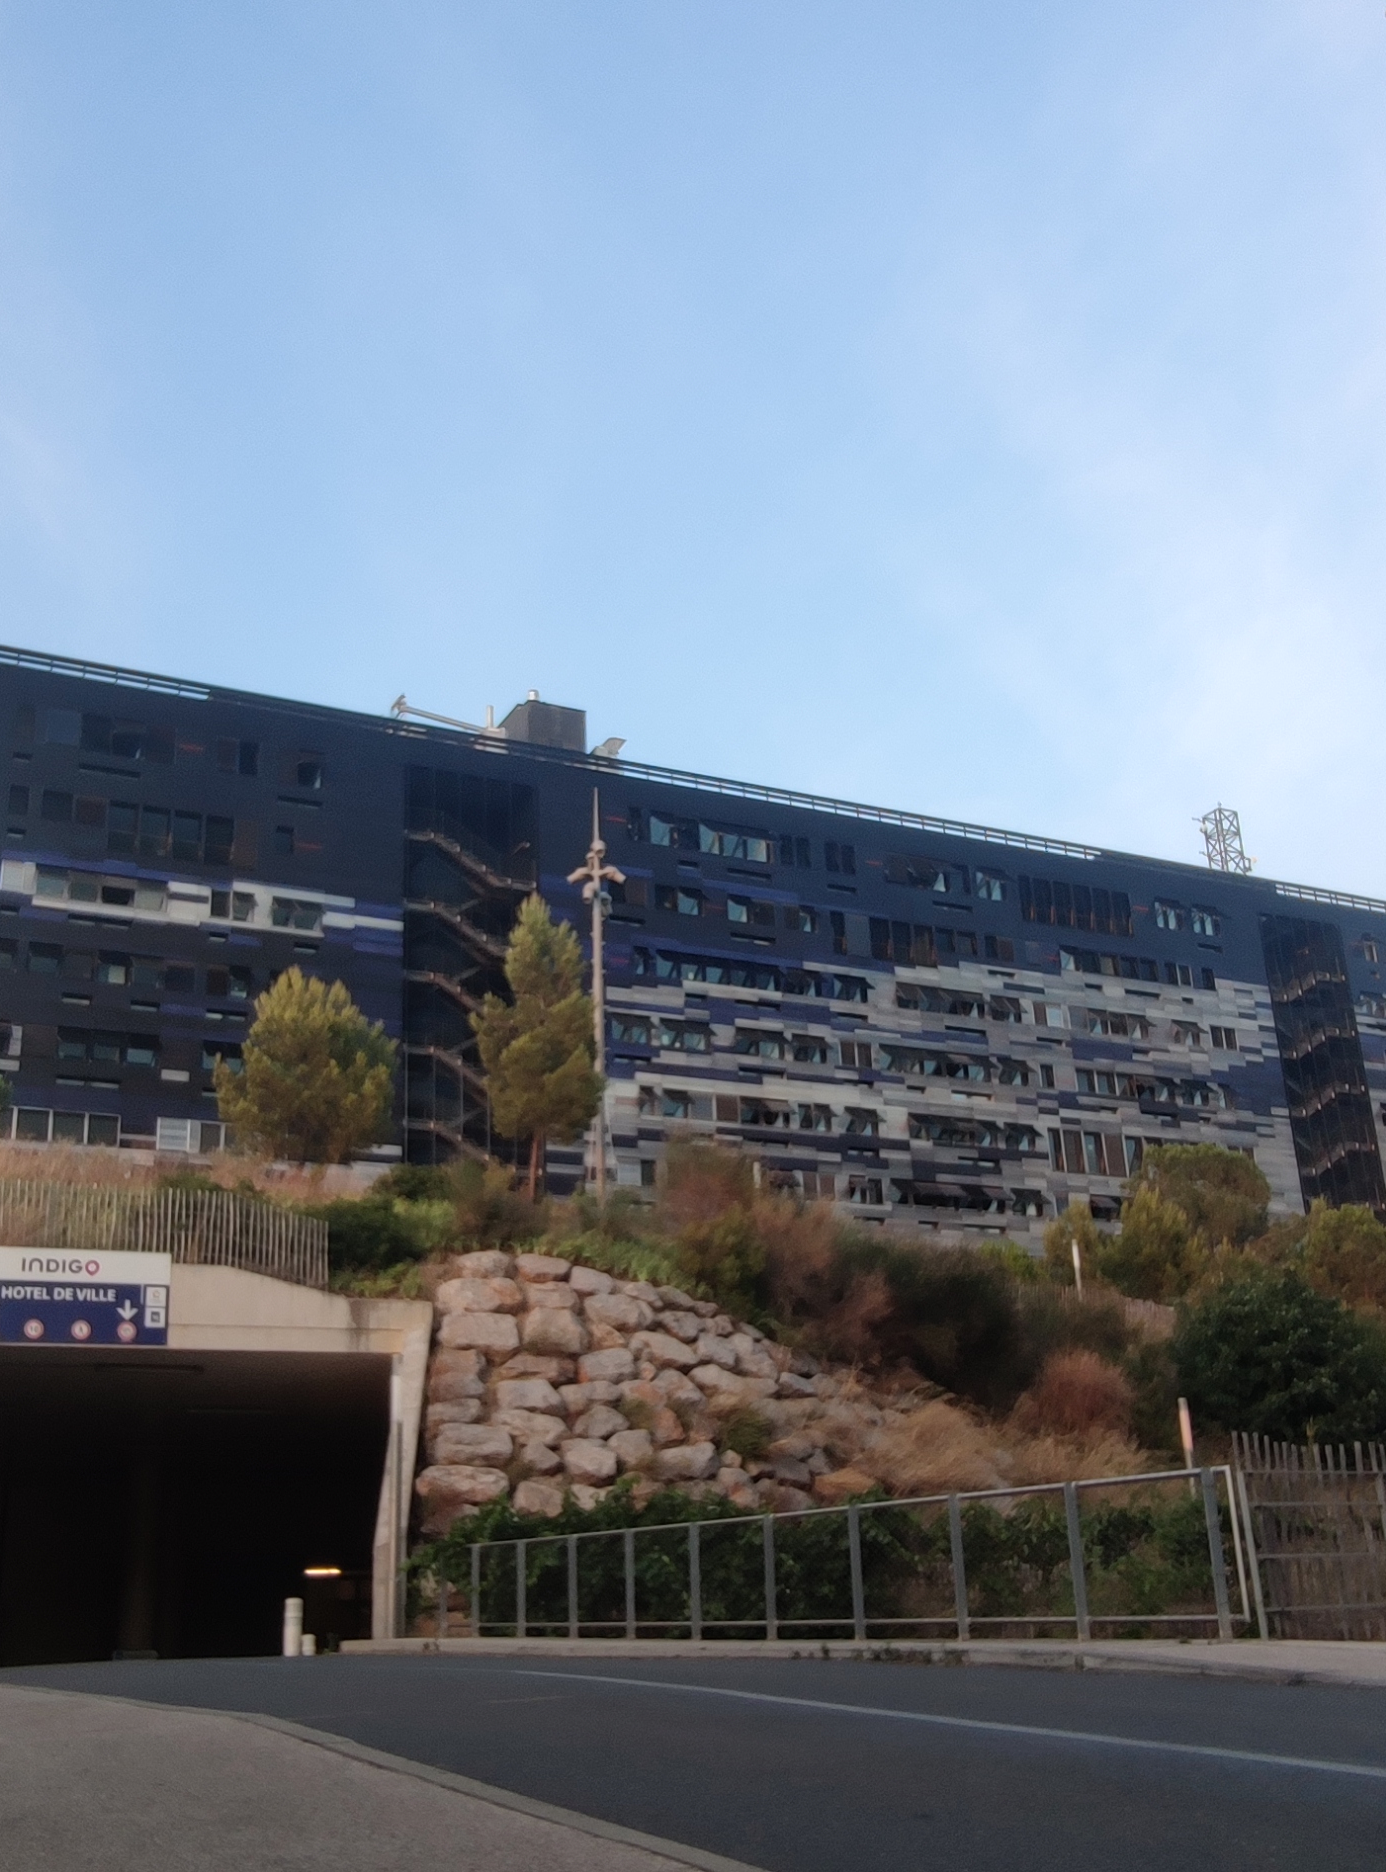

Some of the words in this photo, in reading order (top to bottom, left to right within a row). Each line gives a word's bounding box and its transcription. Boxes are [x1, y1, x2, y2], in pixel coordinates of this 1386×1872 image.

[21, 1258, 100, 1276] INDIGO
[1, 1285, 50, 1301] HOTEL
[53, 1286, 74, 1301] DE
[76, 1288, 116, 1302] VILLE
